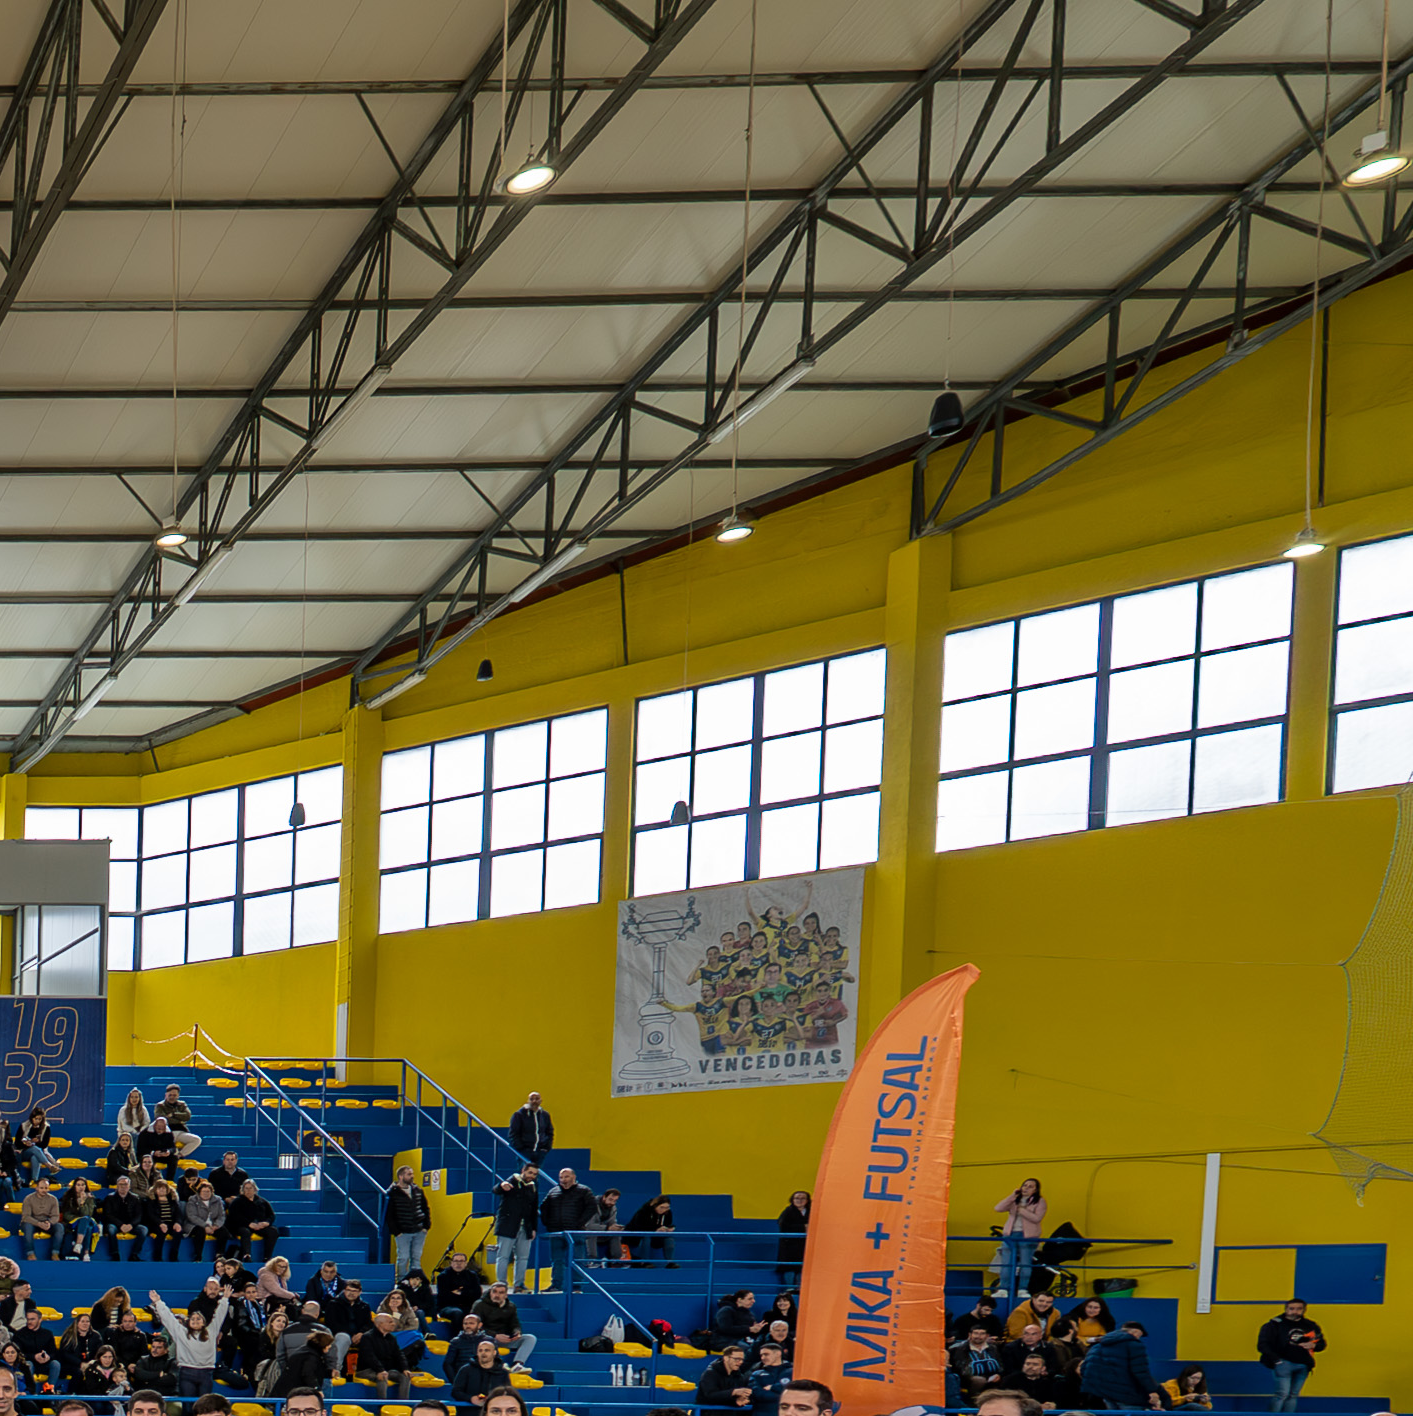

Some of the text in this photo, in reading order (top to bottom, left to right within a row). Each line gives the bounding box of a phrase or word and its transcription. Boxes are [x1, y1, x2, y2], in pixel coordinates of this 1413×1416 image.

[699, 1049, 842, 1074] VENCEDORAS
[863, 1035, 929, 1202] FUTSAL
[842, 1269, 895, 1383] MKA
